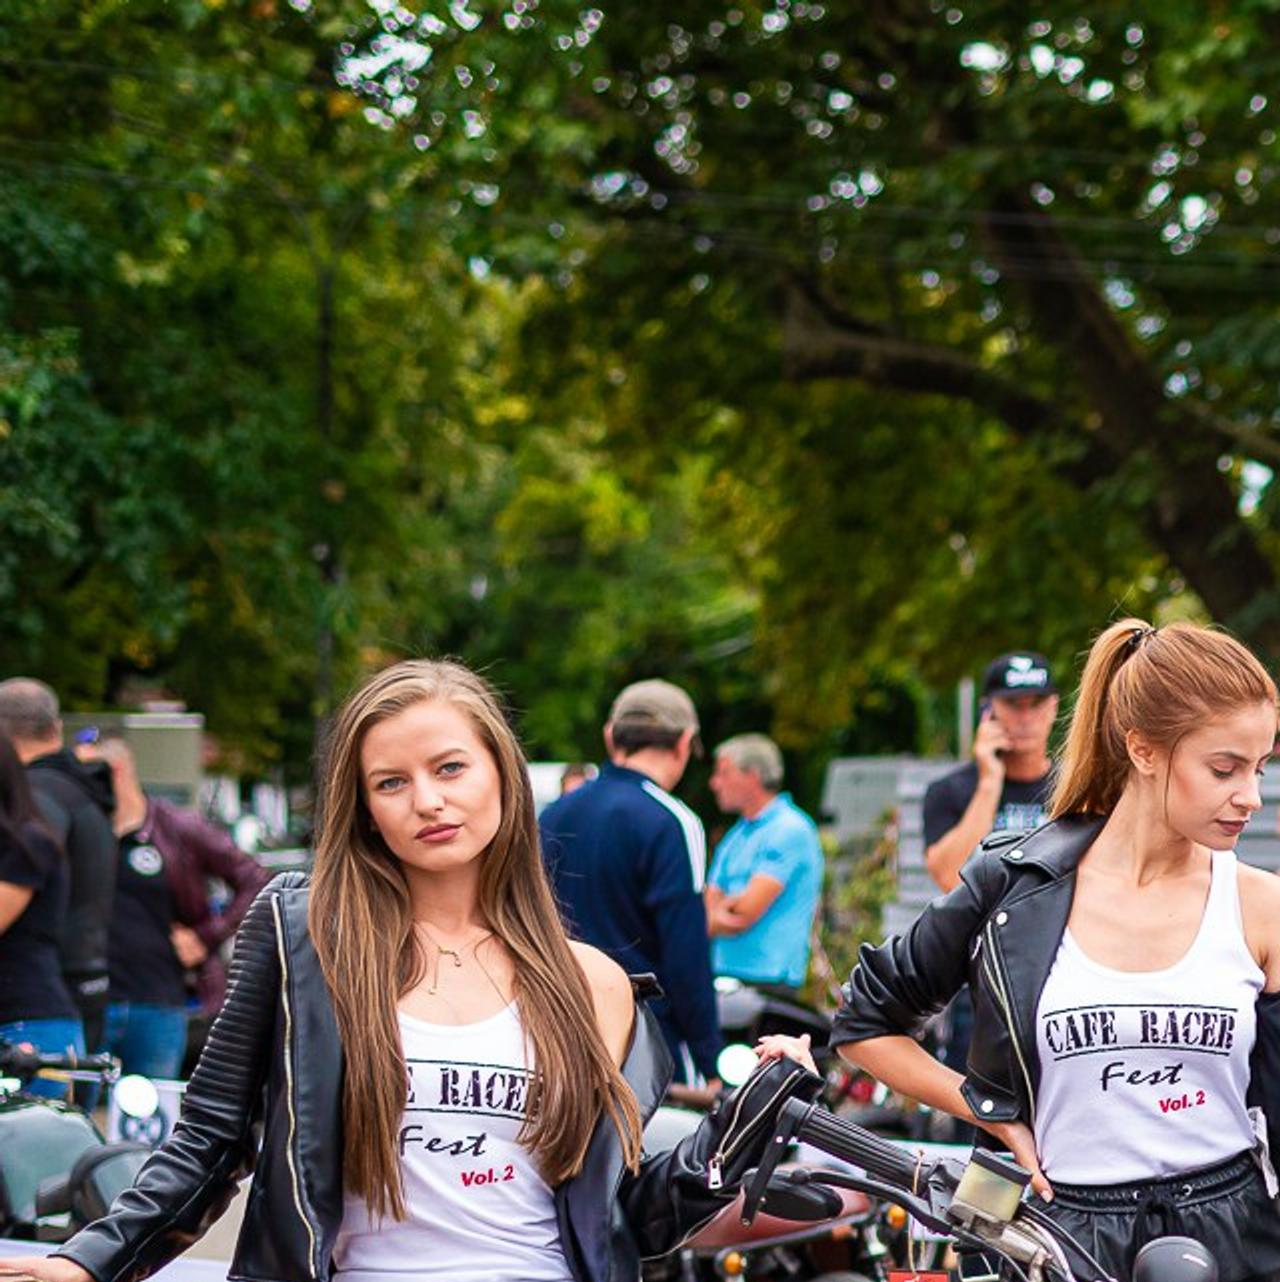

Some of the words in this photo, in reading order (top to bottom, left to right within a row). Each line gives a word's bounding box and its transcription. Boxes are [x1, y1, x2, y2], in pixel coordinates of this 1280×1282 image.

[1046, 1011, 1117, 1053] CAFE
[1139, 1010, 1236, 1049] RACER
[1100, 1062, 1183, 1091] Fest
[1159, 1094, 1193, 1113] Vol.
[1196, 1090, 1206, 1105] 2
[399, 1126, 486, 1156] Fest
[461, 1168, 498, 1186] Vol.
[502, 1165, 514, 1181] 2
